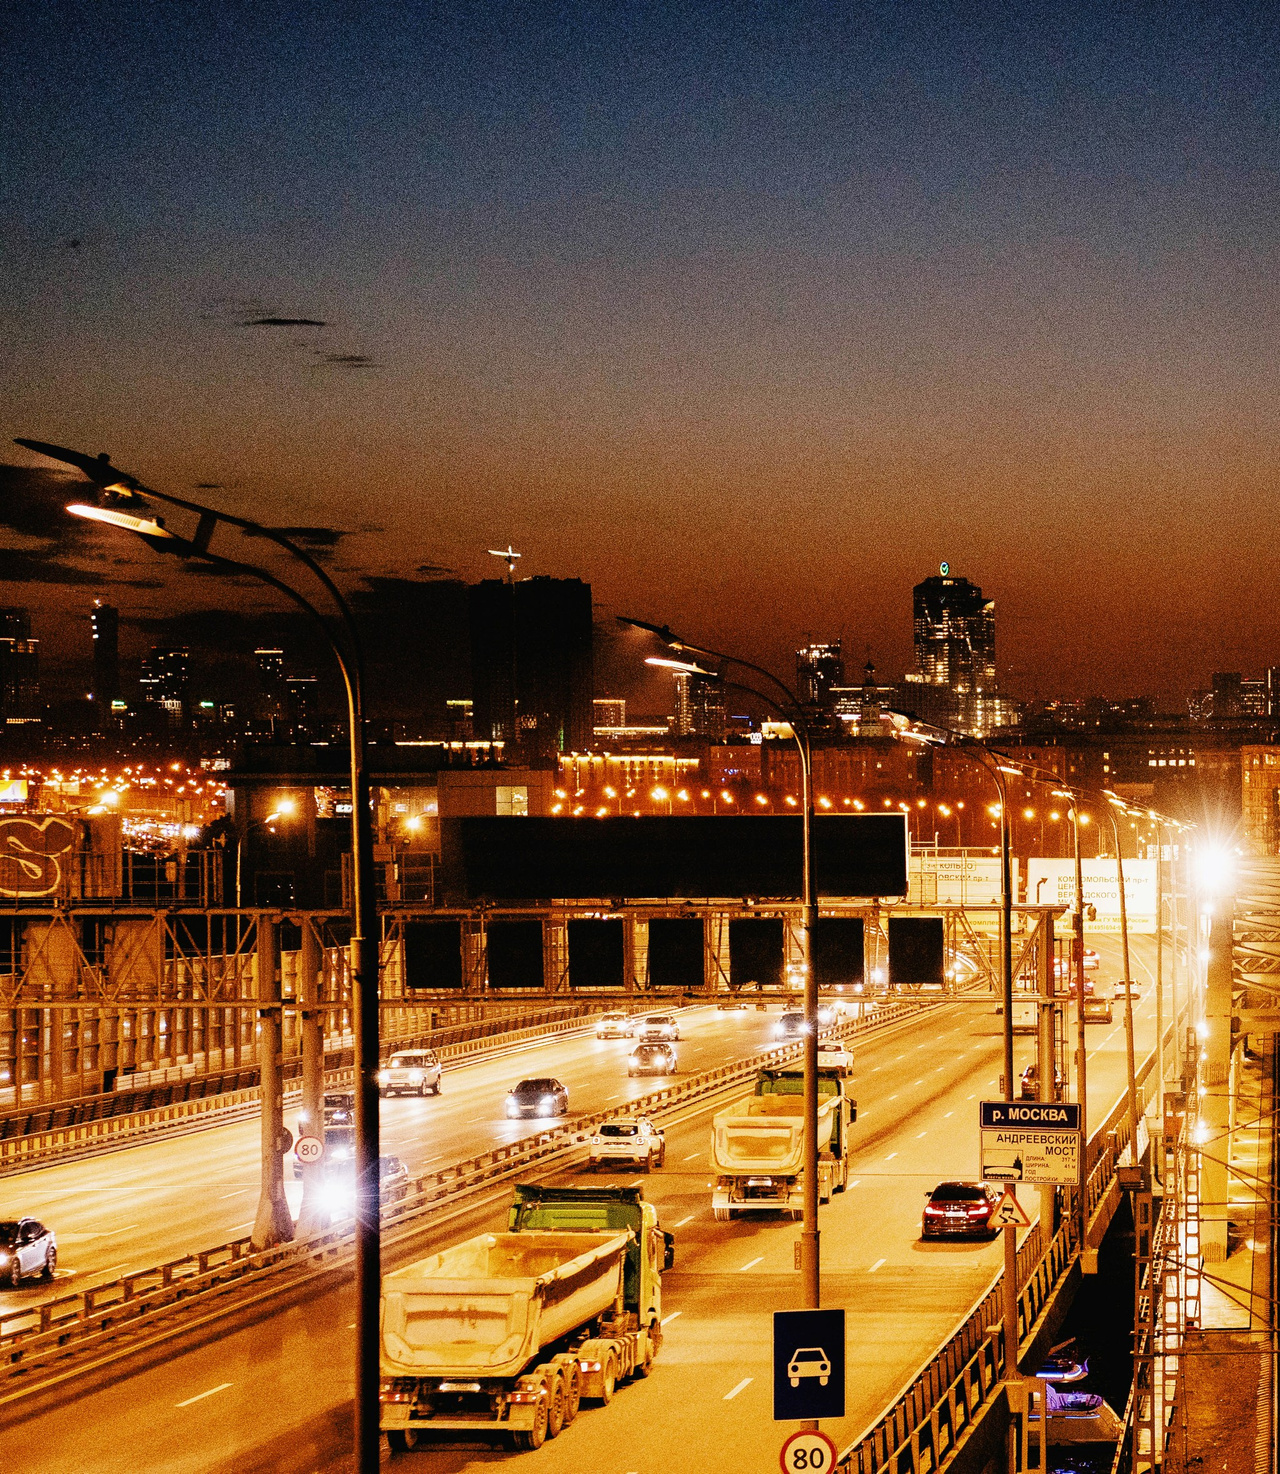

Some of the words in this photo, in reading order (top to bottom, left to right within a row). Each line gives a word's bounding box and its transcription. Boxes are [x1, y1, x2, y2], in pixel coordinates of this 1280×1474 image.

[992, 1111, 1005, 1122] р.
[1008, 1107, 1068, 1122] МОСКВА
[996, 1133, 1077, 1145] АНДРЕЕВСКИЙ
[301, 1144, 318, 1155] 80
[1045, 1146, 1076, 1156] МОСТ
[793, 1447, 825, 1470] 80
